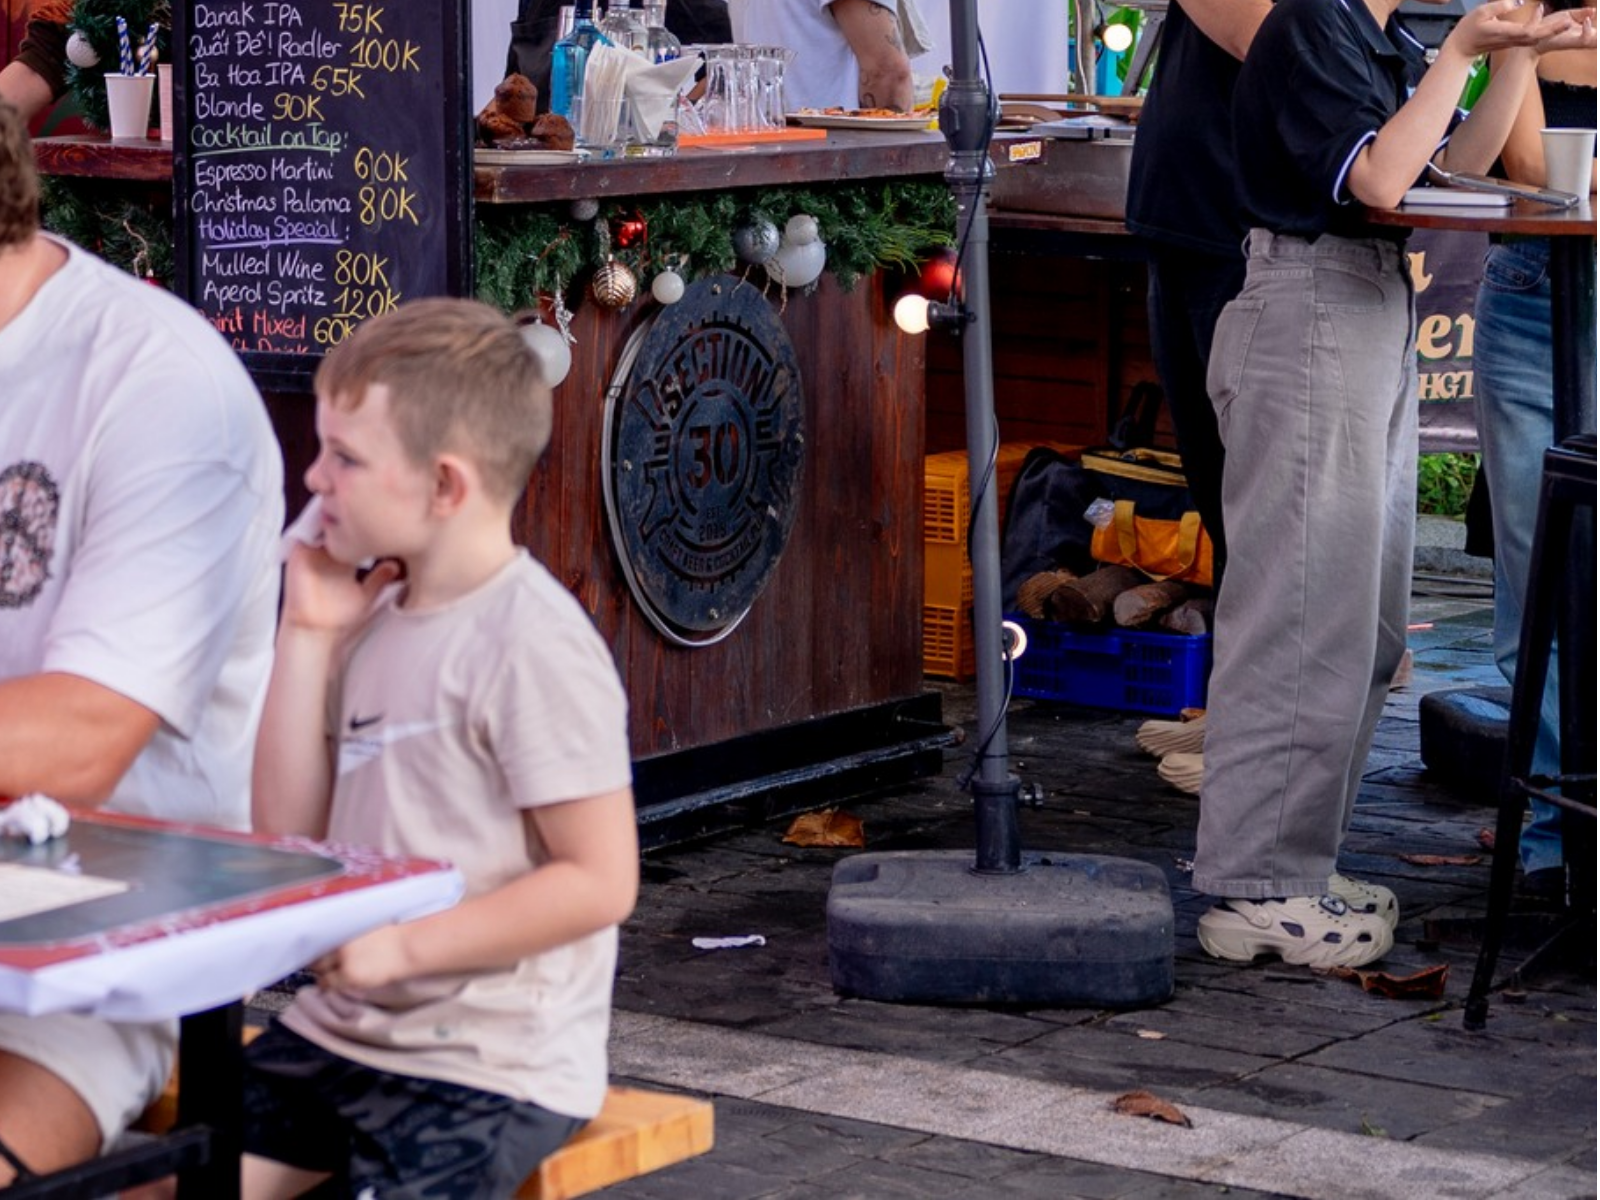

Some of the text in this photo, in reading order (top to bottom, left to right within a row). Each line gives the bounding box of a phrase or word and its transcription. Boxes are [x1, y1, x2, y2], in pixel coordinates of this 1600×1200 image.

[263, 3, 303, 27] IPA
[278, 28, 342, 58] Radler
[195, 63, 220, 88] Ba
[228, 65, 262, 86] Hoa
[265, 63, 305, 86] IPA
[195, 93, 266, 121] Blonde
[191, 122, 272, 148] Cocktail
[280, 132, 306, 150] on
[195, 159, 267, 191] Espresso
[271, 157, 334, 182] Martini
[191, 187, 277, 213] Christmas
[283, 187, 351, 213] Paloma
[199, 218, 270, 249] Holiday
[202, 251, 270, 277] Mulled
[277, 253, 326, 281] Wine
[204, 280, 261, 311] Aperol
[267, 280, 327, 315] Spritz
[253, 309, 305, 339] Mixed
[659, 333, 767, 422] SECTION
[687, 423, 740, 489] 30
